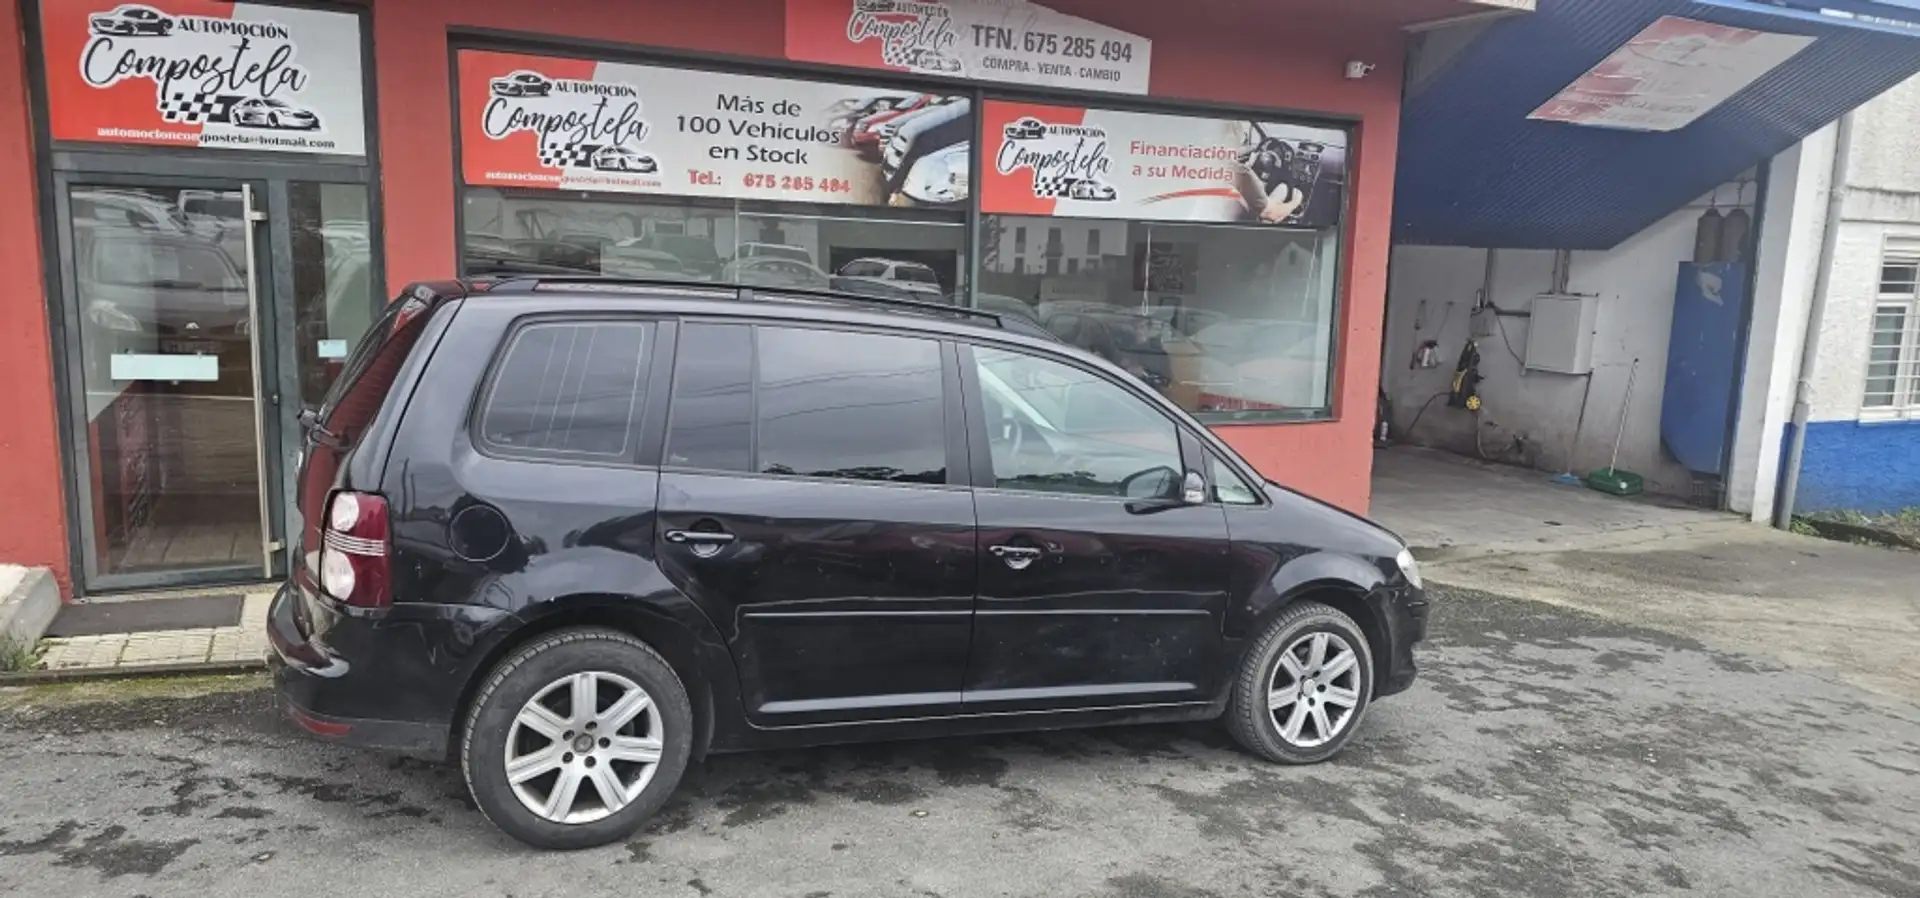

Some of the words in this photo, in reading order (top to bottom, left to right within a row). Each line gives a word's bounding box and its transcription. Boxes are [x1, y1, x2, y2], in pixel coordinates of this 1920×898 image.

[178, 18, 289, 40] AUTOMOCIÓN
[849, 12, 955, 54] Compostela
[971, 24, 1017, 51] TFN.
[1024, 31, 1057, 55] 675
[1062, 36, 1095, 59] 285
[1100, 41, 1132, 63] 494
[84, 37, 307, 100] Compostela
[982, 56, 1030, 73] COMPRA
[1037, 63, 1072, 77] VENTA
[1079, 67, 1121, 82] CAMBIO
[716, 94, 765, 114] Más
[772, 100, 802, 117] de
[485, 97, 649, 148] Compostela
[676, 115, 721, 135] 100
[709, 146, 739, 160] en
[746, 144, 808, 165] Stock
[998, 138, 1112, 182] Compostela
[1130, 140, 1239, 161] Financiación
[743, 173, 776, 189] 675
[1132, 165, 1142, 177] a
[1147, 165, 1167, 178] su
[1171, 164, 1235, 182] Medida
